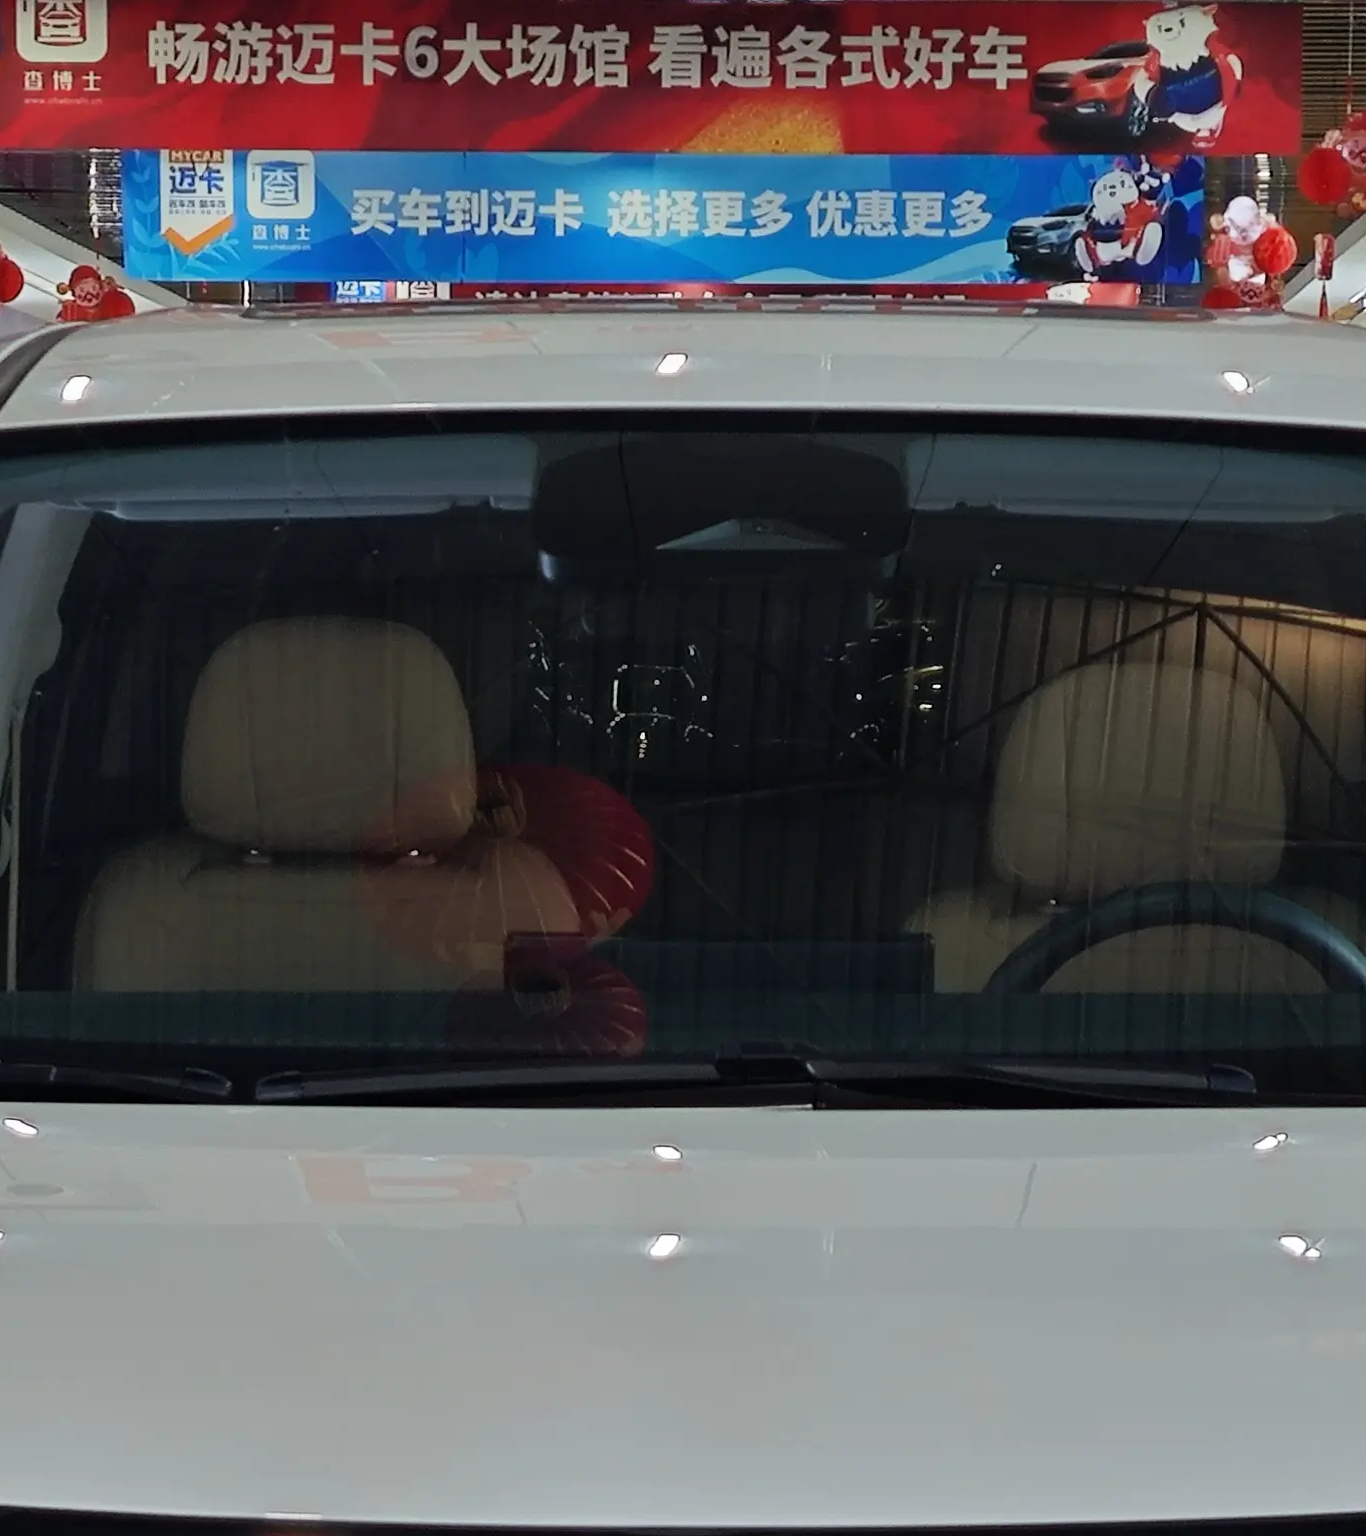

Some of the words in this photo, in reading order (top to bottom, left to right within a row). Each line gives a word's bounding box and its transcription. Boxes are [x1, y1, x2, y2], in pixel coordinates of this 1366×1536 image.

[147, 20, 629, 88] 畅游迈卡6大场馆
[648, 24, 1030, 90] 看遍各式好车
[23, 70, 102, 92] 查博士
[170, 150, 224, 162] MYCAR
[169, 165, 224, 195] 迈卡
[349, 188, 584, 238] 买车到迈卡
[606, 188, 795, 238] 选择更多
[807, 188, 993, 239] 优惠更多
[252, 224, 312, 241] 查博士
